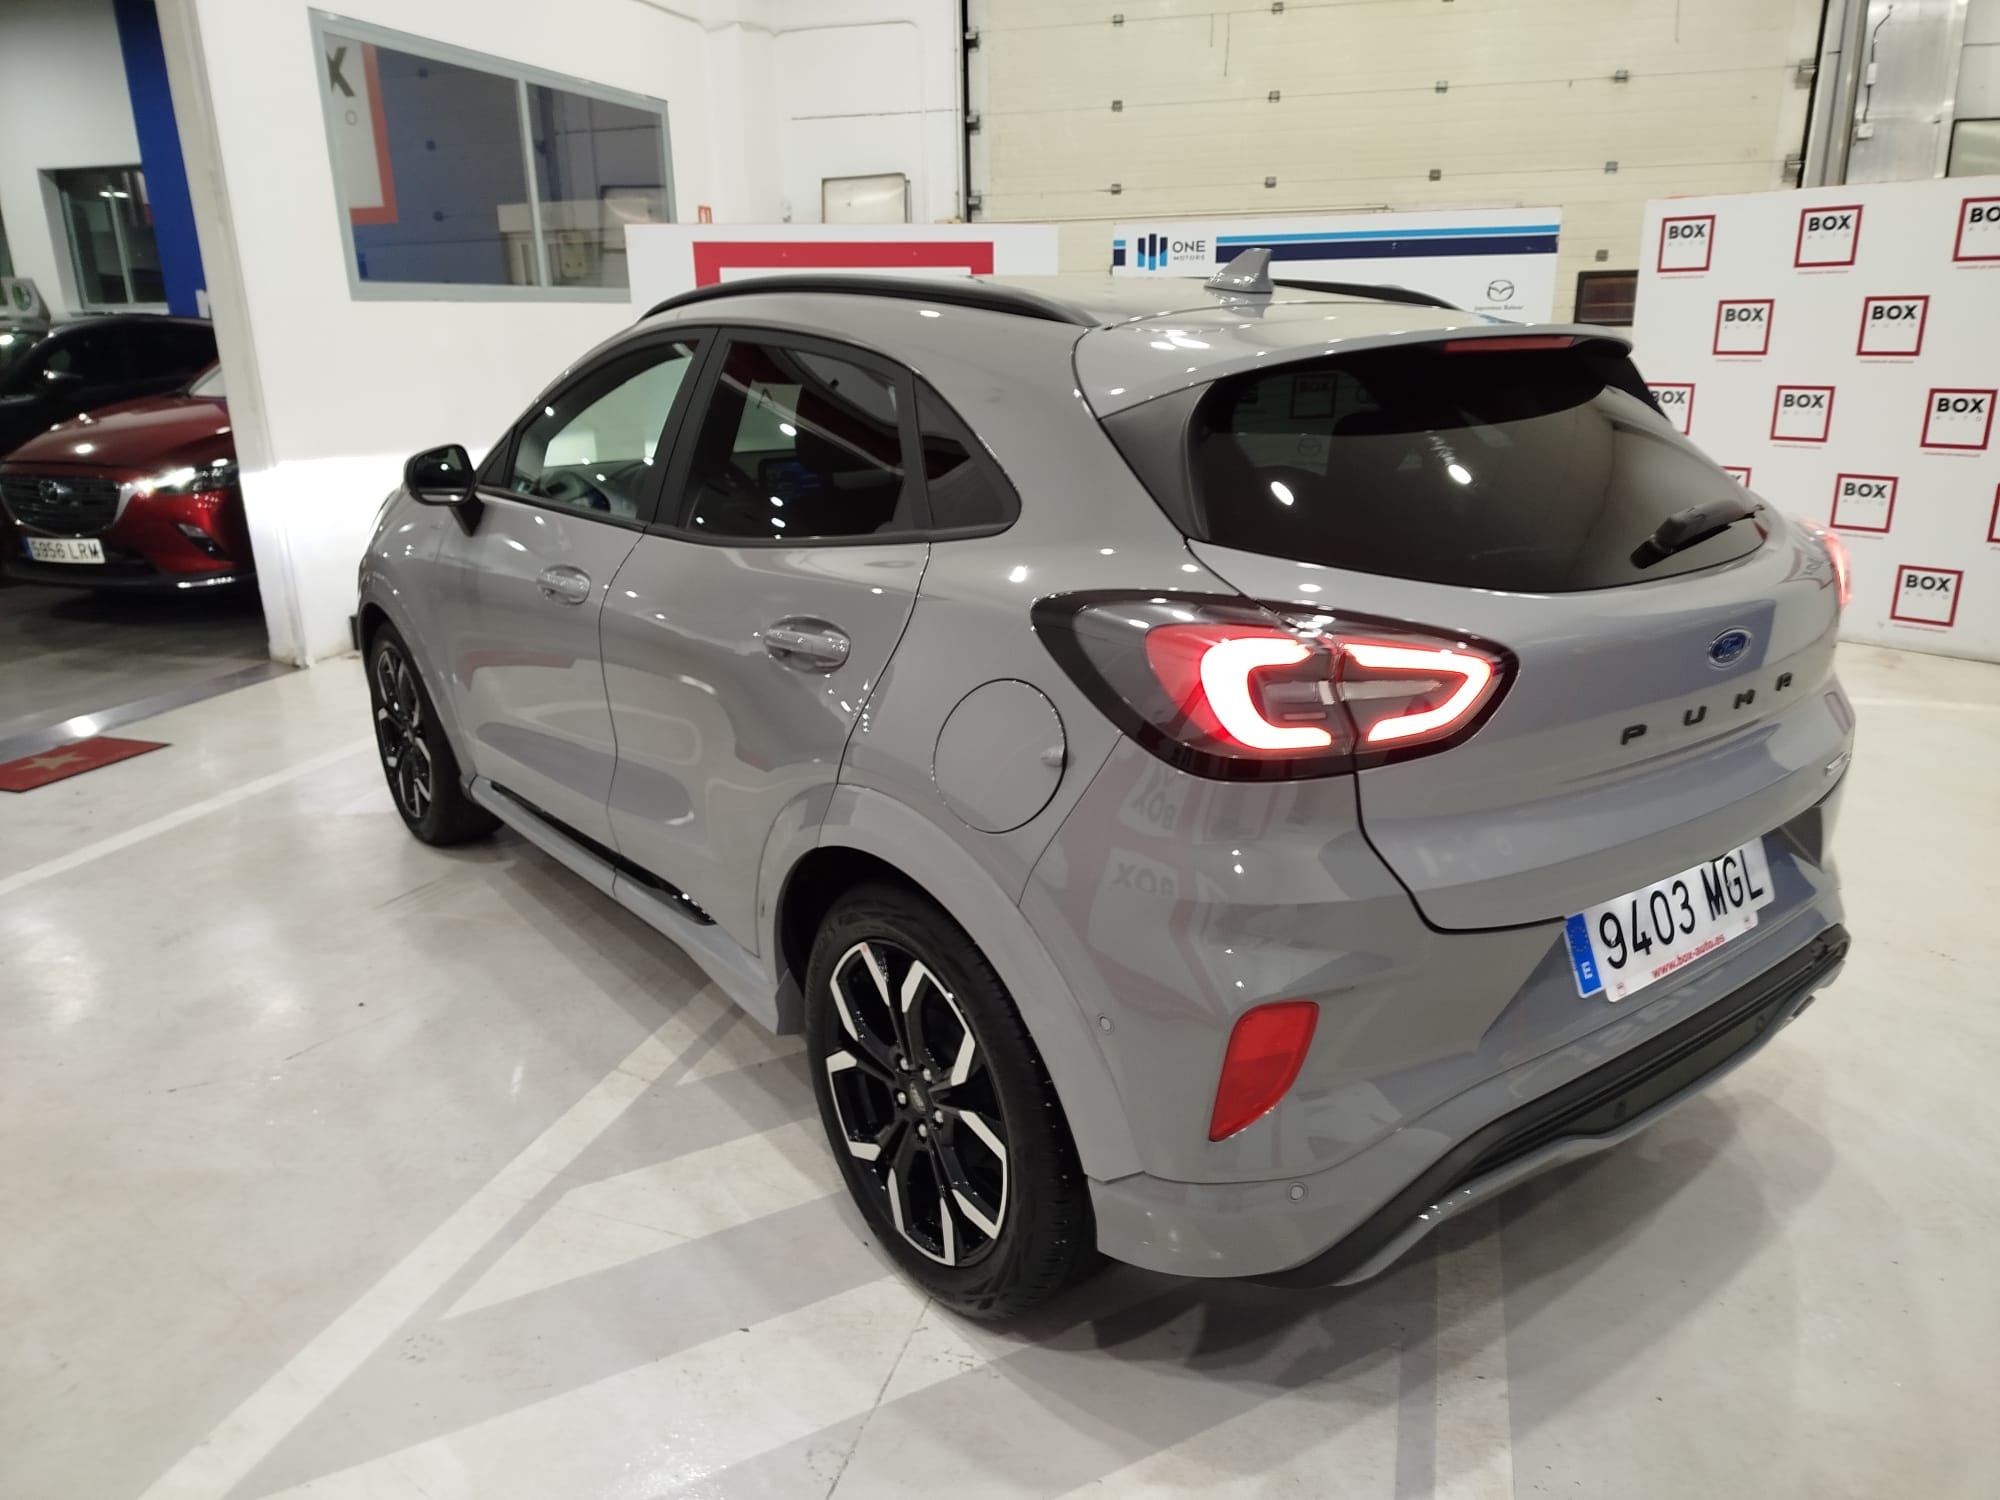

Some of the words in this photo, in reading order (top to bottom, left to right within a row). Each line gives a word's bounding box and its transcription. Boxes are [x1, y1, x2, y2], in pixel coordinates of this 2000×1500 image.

[1808, 214, 1852, 231] BOX
[1969, 206, 2000, 223] BO
[1668, 223, 1706, 239] BOX
[1172, 240, 1206, 253] ONE
[1725, 307, 1765, 322] BOX
[1872, 304, 1918, 320] BOX
[1783, 393, 1825, 408] BOX
[1936, 397, 1986, 413] BOX
[1844, 482, 1888, 498] BOX
[1906, 574, 1951, 592] BOX
[1620, 672, 1793, 746] PUMA
[1599, 880, 1696, 970] 9403
[1700, 849, 1764, 921] MGL
[1581, 960, 1593, 980] E
